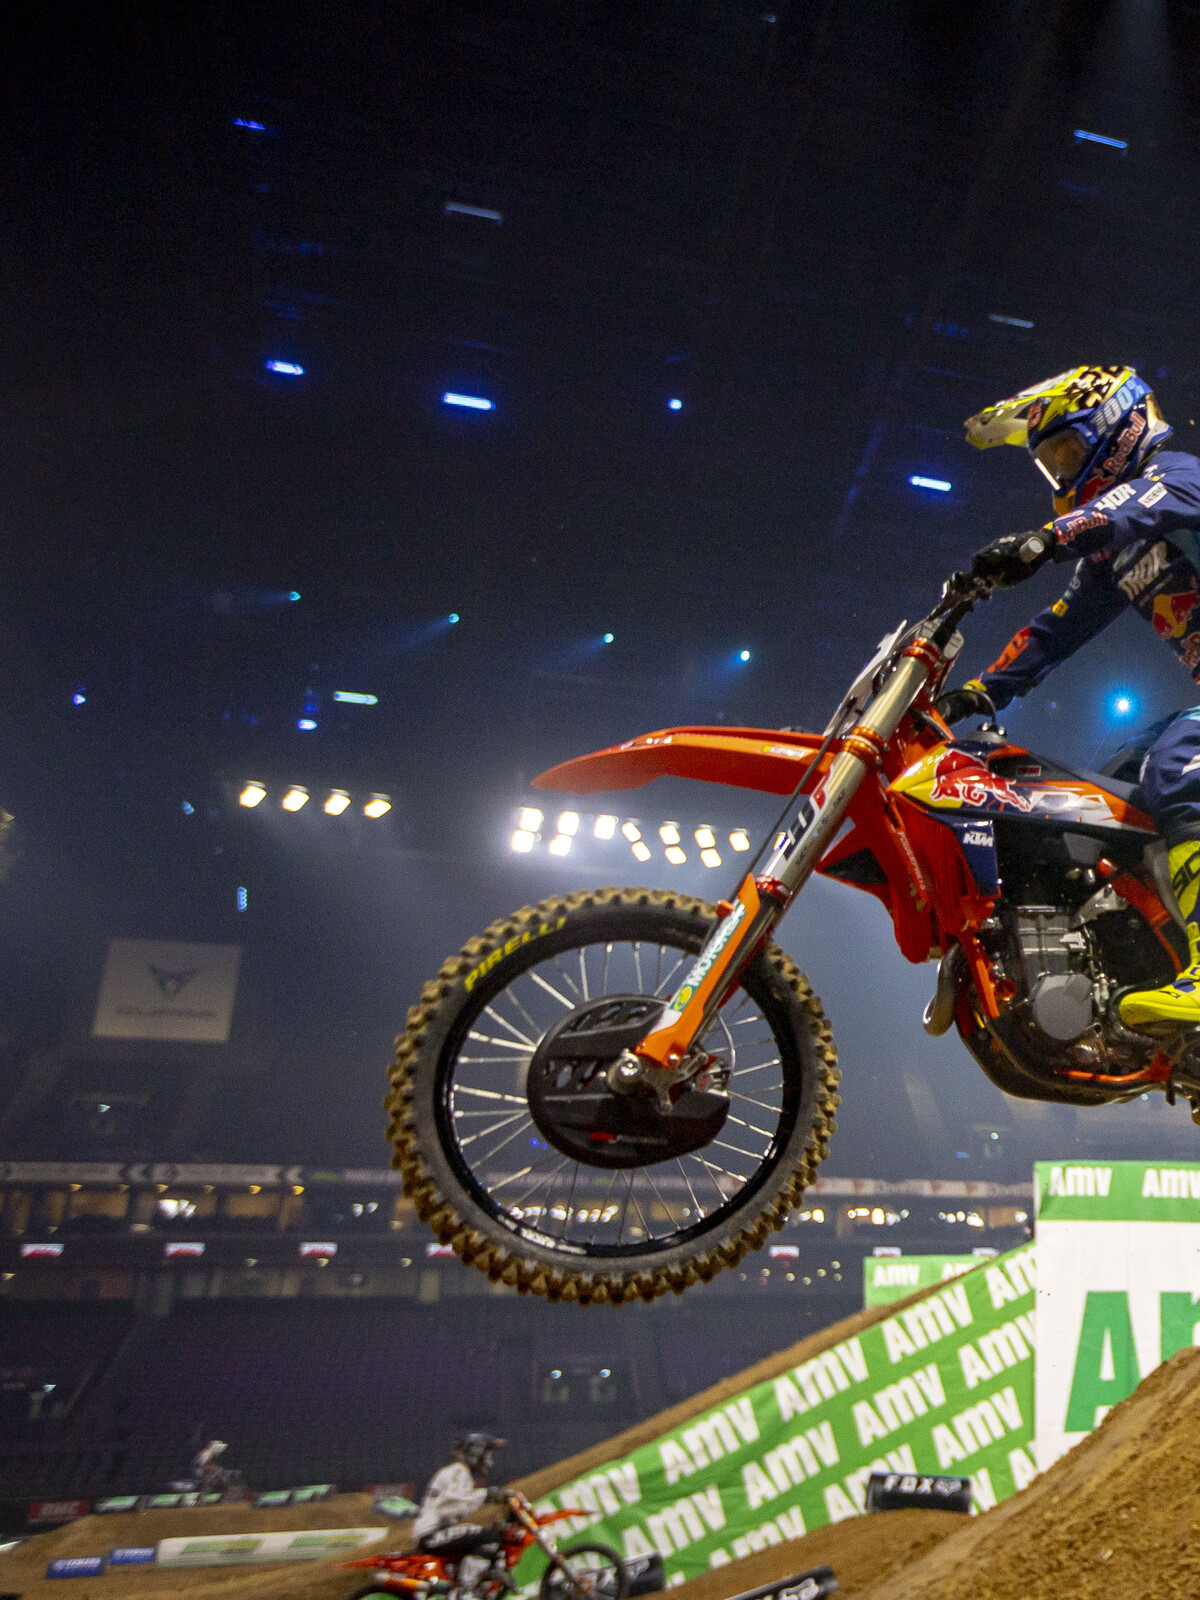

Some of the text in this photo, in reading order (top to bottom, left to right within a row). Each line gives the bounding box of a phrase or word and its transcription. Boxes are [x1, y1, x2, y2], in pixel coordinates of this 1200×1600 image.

[1091, 379, 1146, 436] 100%
[1103, 411, 1146, 475] Red Bull
[1118, 541, 1170, 601] THOR
[963, 831, 994, 847] KTM
[465, 916, 567, 992] PIRELLI
[884, 1475, 934, 1494] FOX
